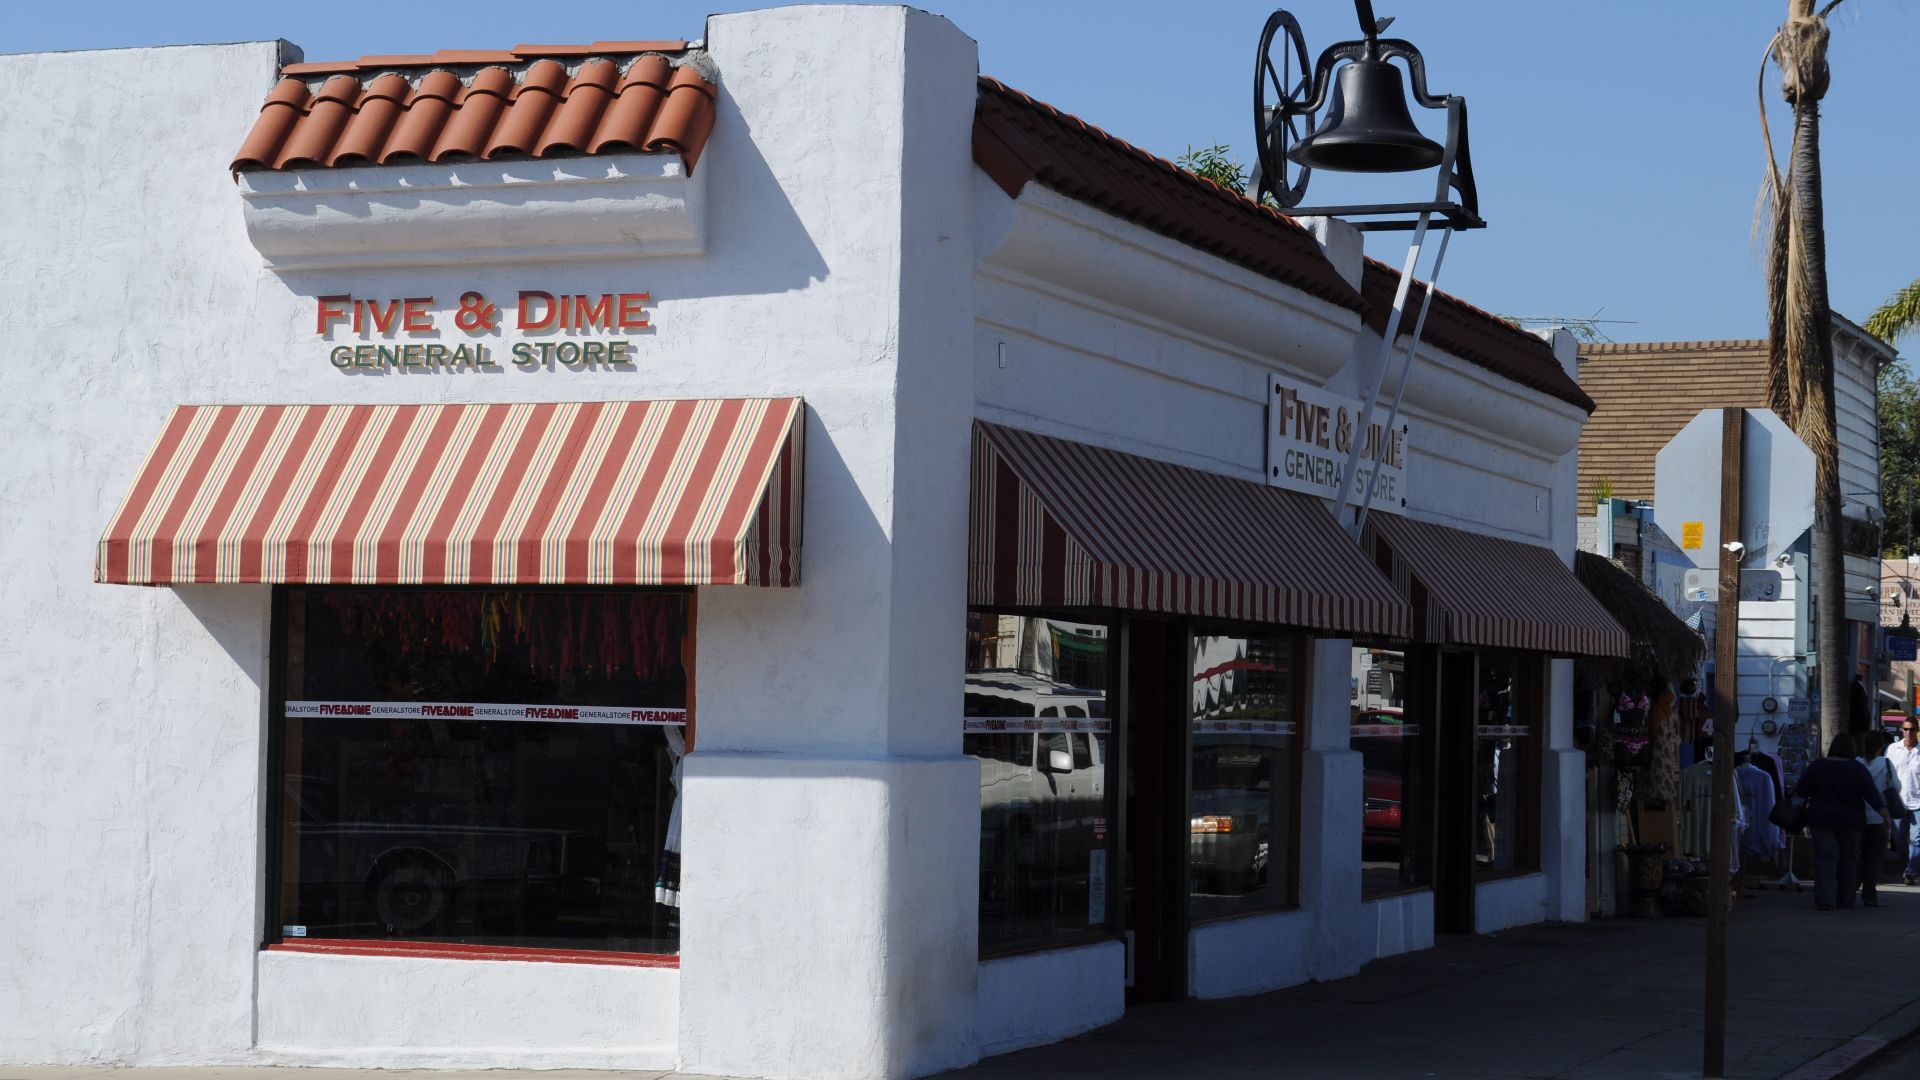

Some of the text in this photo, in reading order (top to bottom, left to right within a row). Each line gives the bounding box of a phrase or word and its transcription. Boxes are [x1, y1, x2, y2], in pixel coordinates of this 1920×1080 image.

[316, 290, 650, 334] FIVE & DIME
[330, 340, 630, 369] GENERAL STORE
[1279, 386, 1330, 449] FIVE
[1335, 406, 1352, 454] &
[1285, 449, 1349, 489] GENERA
[319, 704, 371, 715] FIVE&DIME
[372, 707, 421, 715] GENERALSTORE
[421, 706, 474, 717] FIVE&DIME
[474, 708, 525, 716] GENERALSTORE
[525, 707, 579, 719] FIVE&DIME
[579, 711, 630, 719] GENERALSTORE
[631, 710, 686, 722] FIVE&DIME
